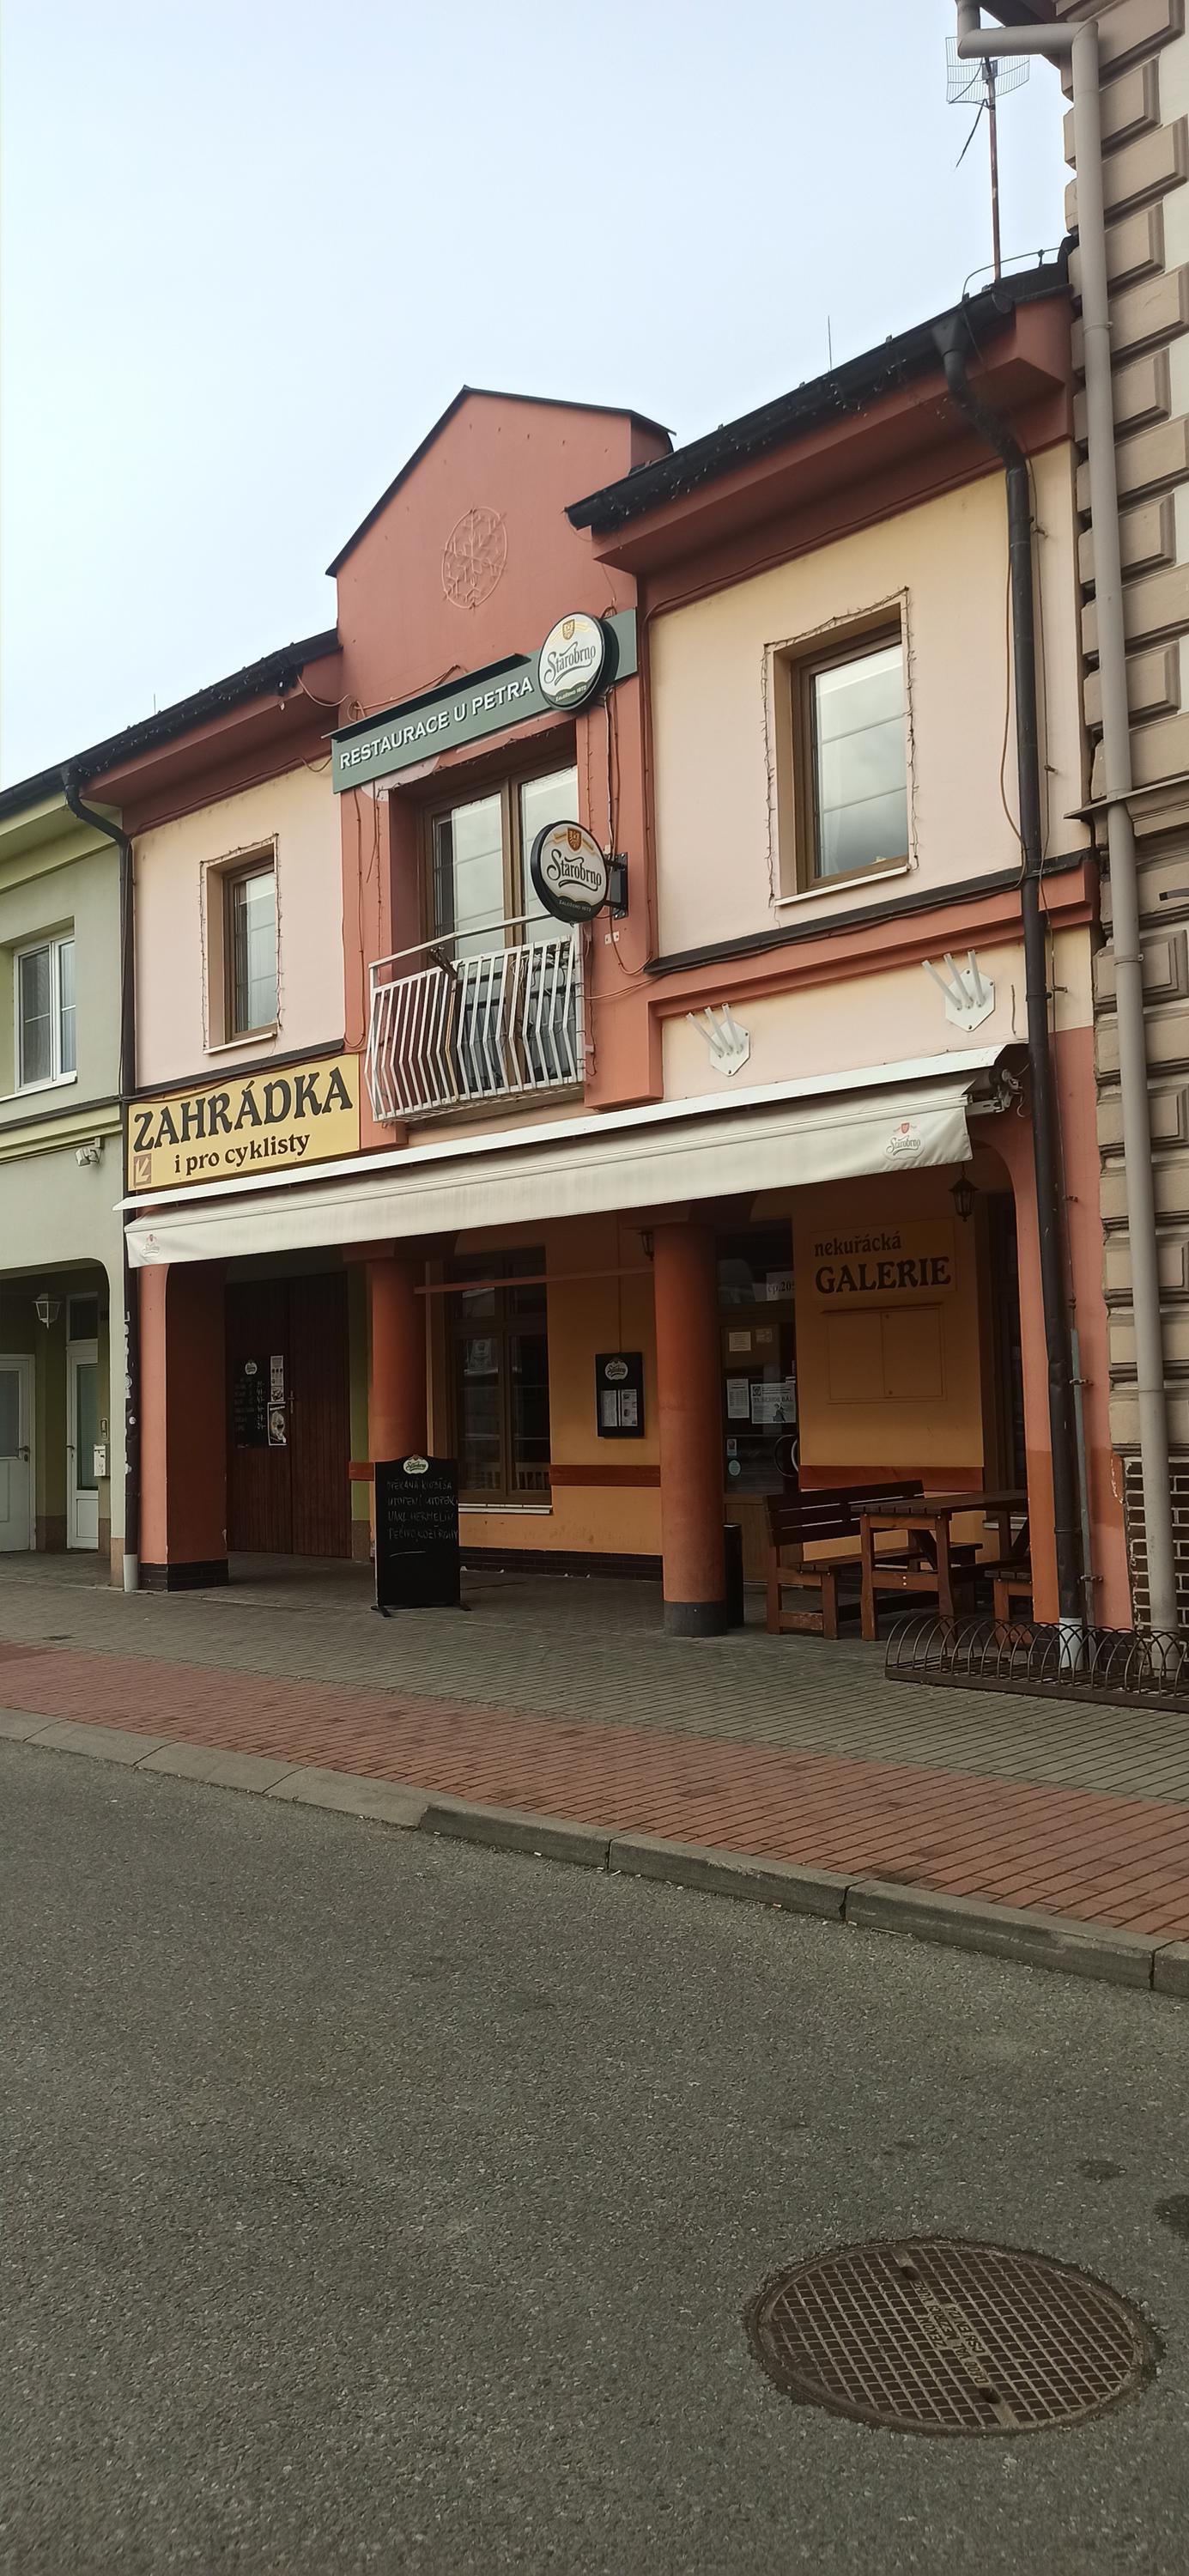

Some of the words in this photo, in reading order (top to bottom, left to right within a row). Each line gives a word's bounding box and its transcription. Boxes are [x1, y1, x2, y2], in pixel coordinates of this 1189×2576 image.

[543, 641, 596, 686] Starobrno
[339, 710, 450, 770] RESTAURACE
[453, 703, 468, 726] U
[470, 677, 534, 715] PETRA
[546, 848, 602, 891] Starobrno
[133, 1066, 353, 1152] ZAHRÁDKA
[175, 1154, 180, 1173] i
[186, 1151, 220, 1176] pro
[225, 1133, 311, 1167] cyklisty
[886, 1135, 921, 1156] Starobrno
[814, 1230, 902, 1257] nekuřácká
[816, 1256, 951, 1294] GALERIE
[918, 2318, 947, 2348] ZEKON
